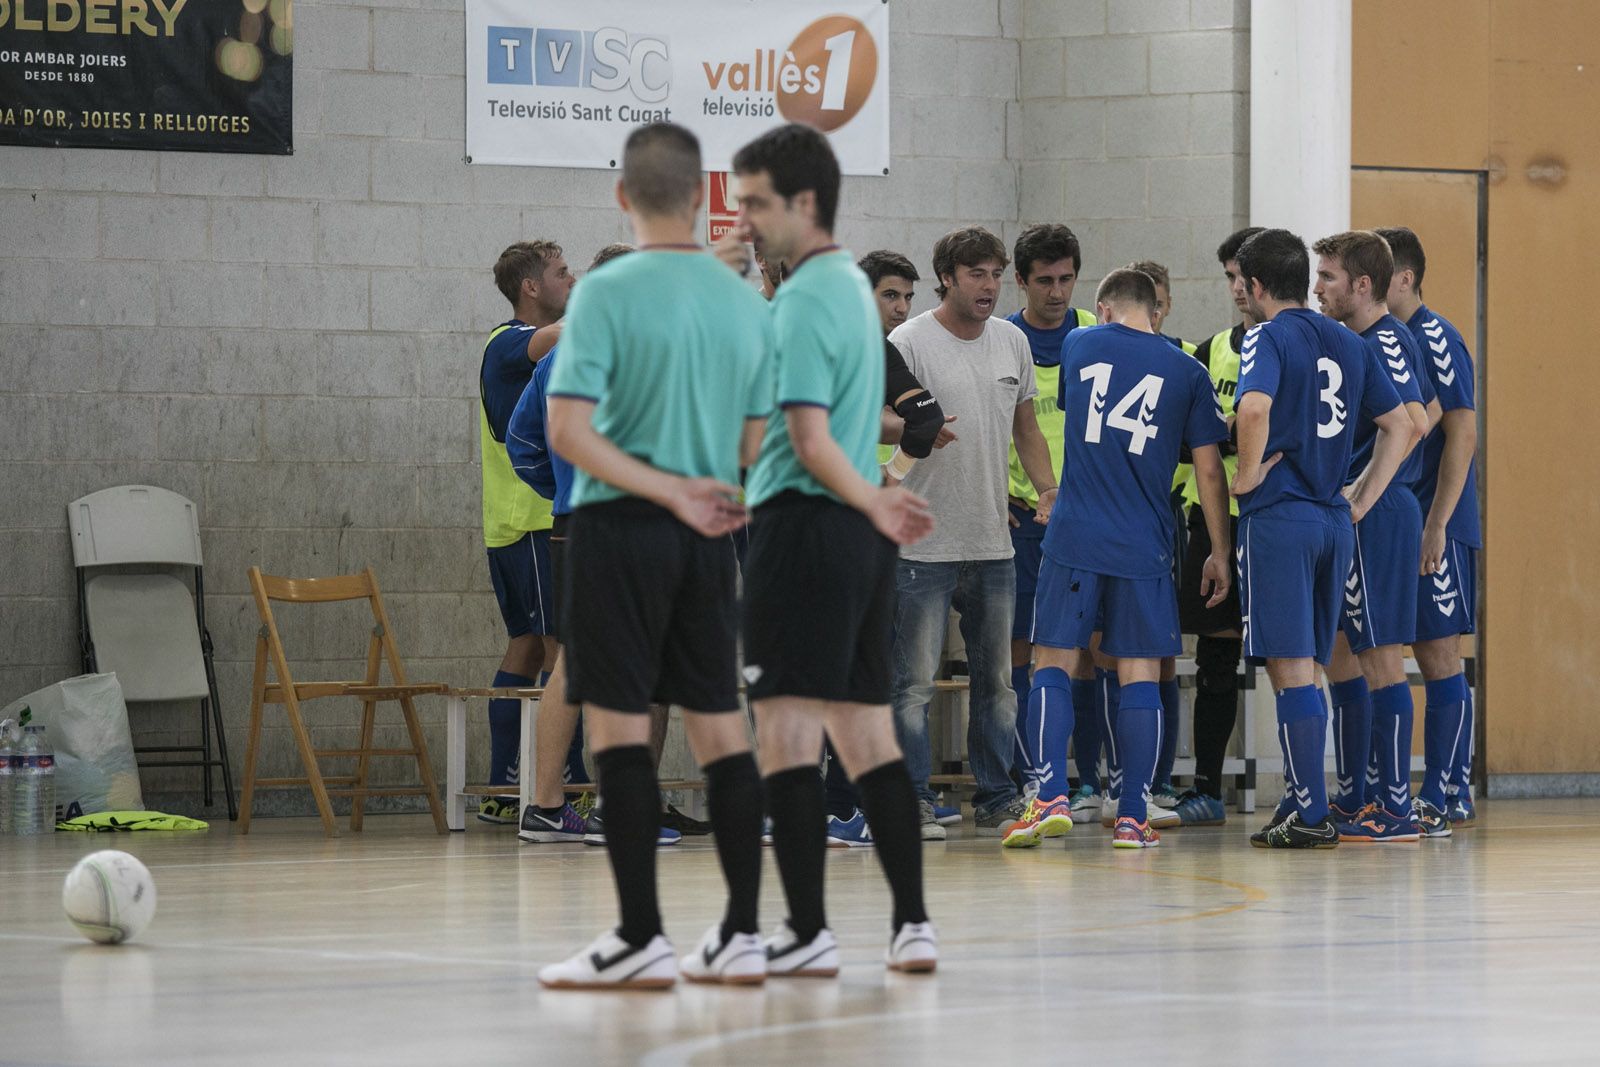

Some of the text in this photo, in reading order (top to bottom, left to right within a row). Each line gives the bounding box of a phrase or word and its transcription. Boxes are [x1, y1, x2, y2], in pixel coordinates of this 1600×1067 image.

[24, 51, 75, 65] AMBAR
[80, 54, 127, 68] JOIERS
[24, 70, 95, 83] DESDE 1880
[488, 99, 671, 127] Televisió Sant Cugat
[703, 95, 775, 118] televisió
[0, 108, 250, 134] A D'OR, JOIES I RELLOTGES
[1079, 362, 1165, 456] 14
[1315, 357, 1347, 439] 3
